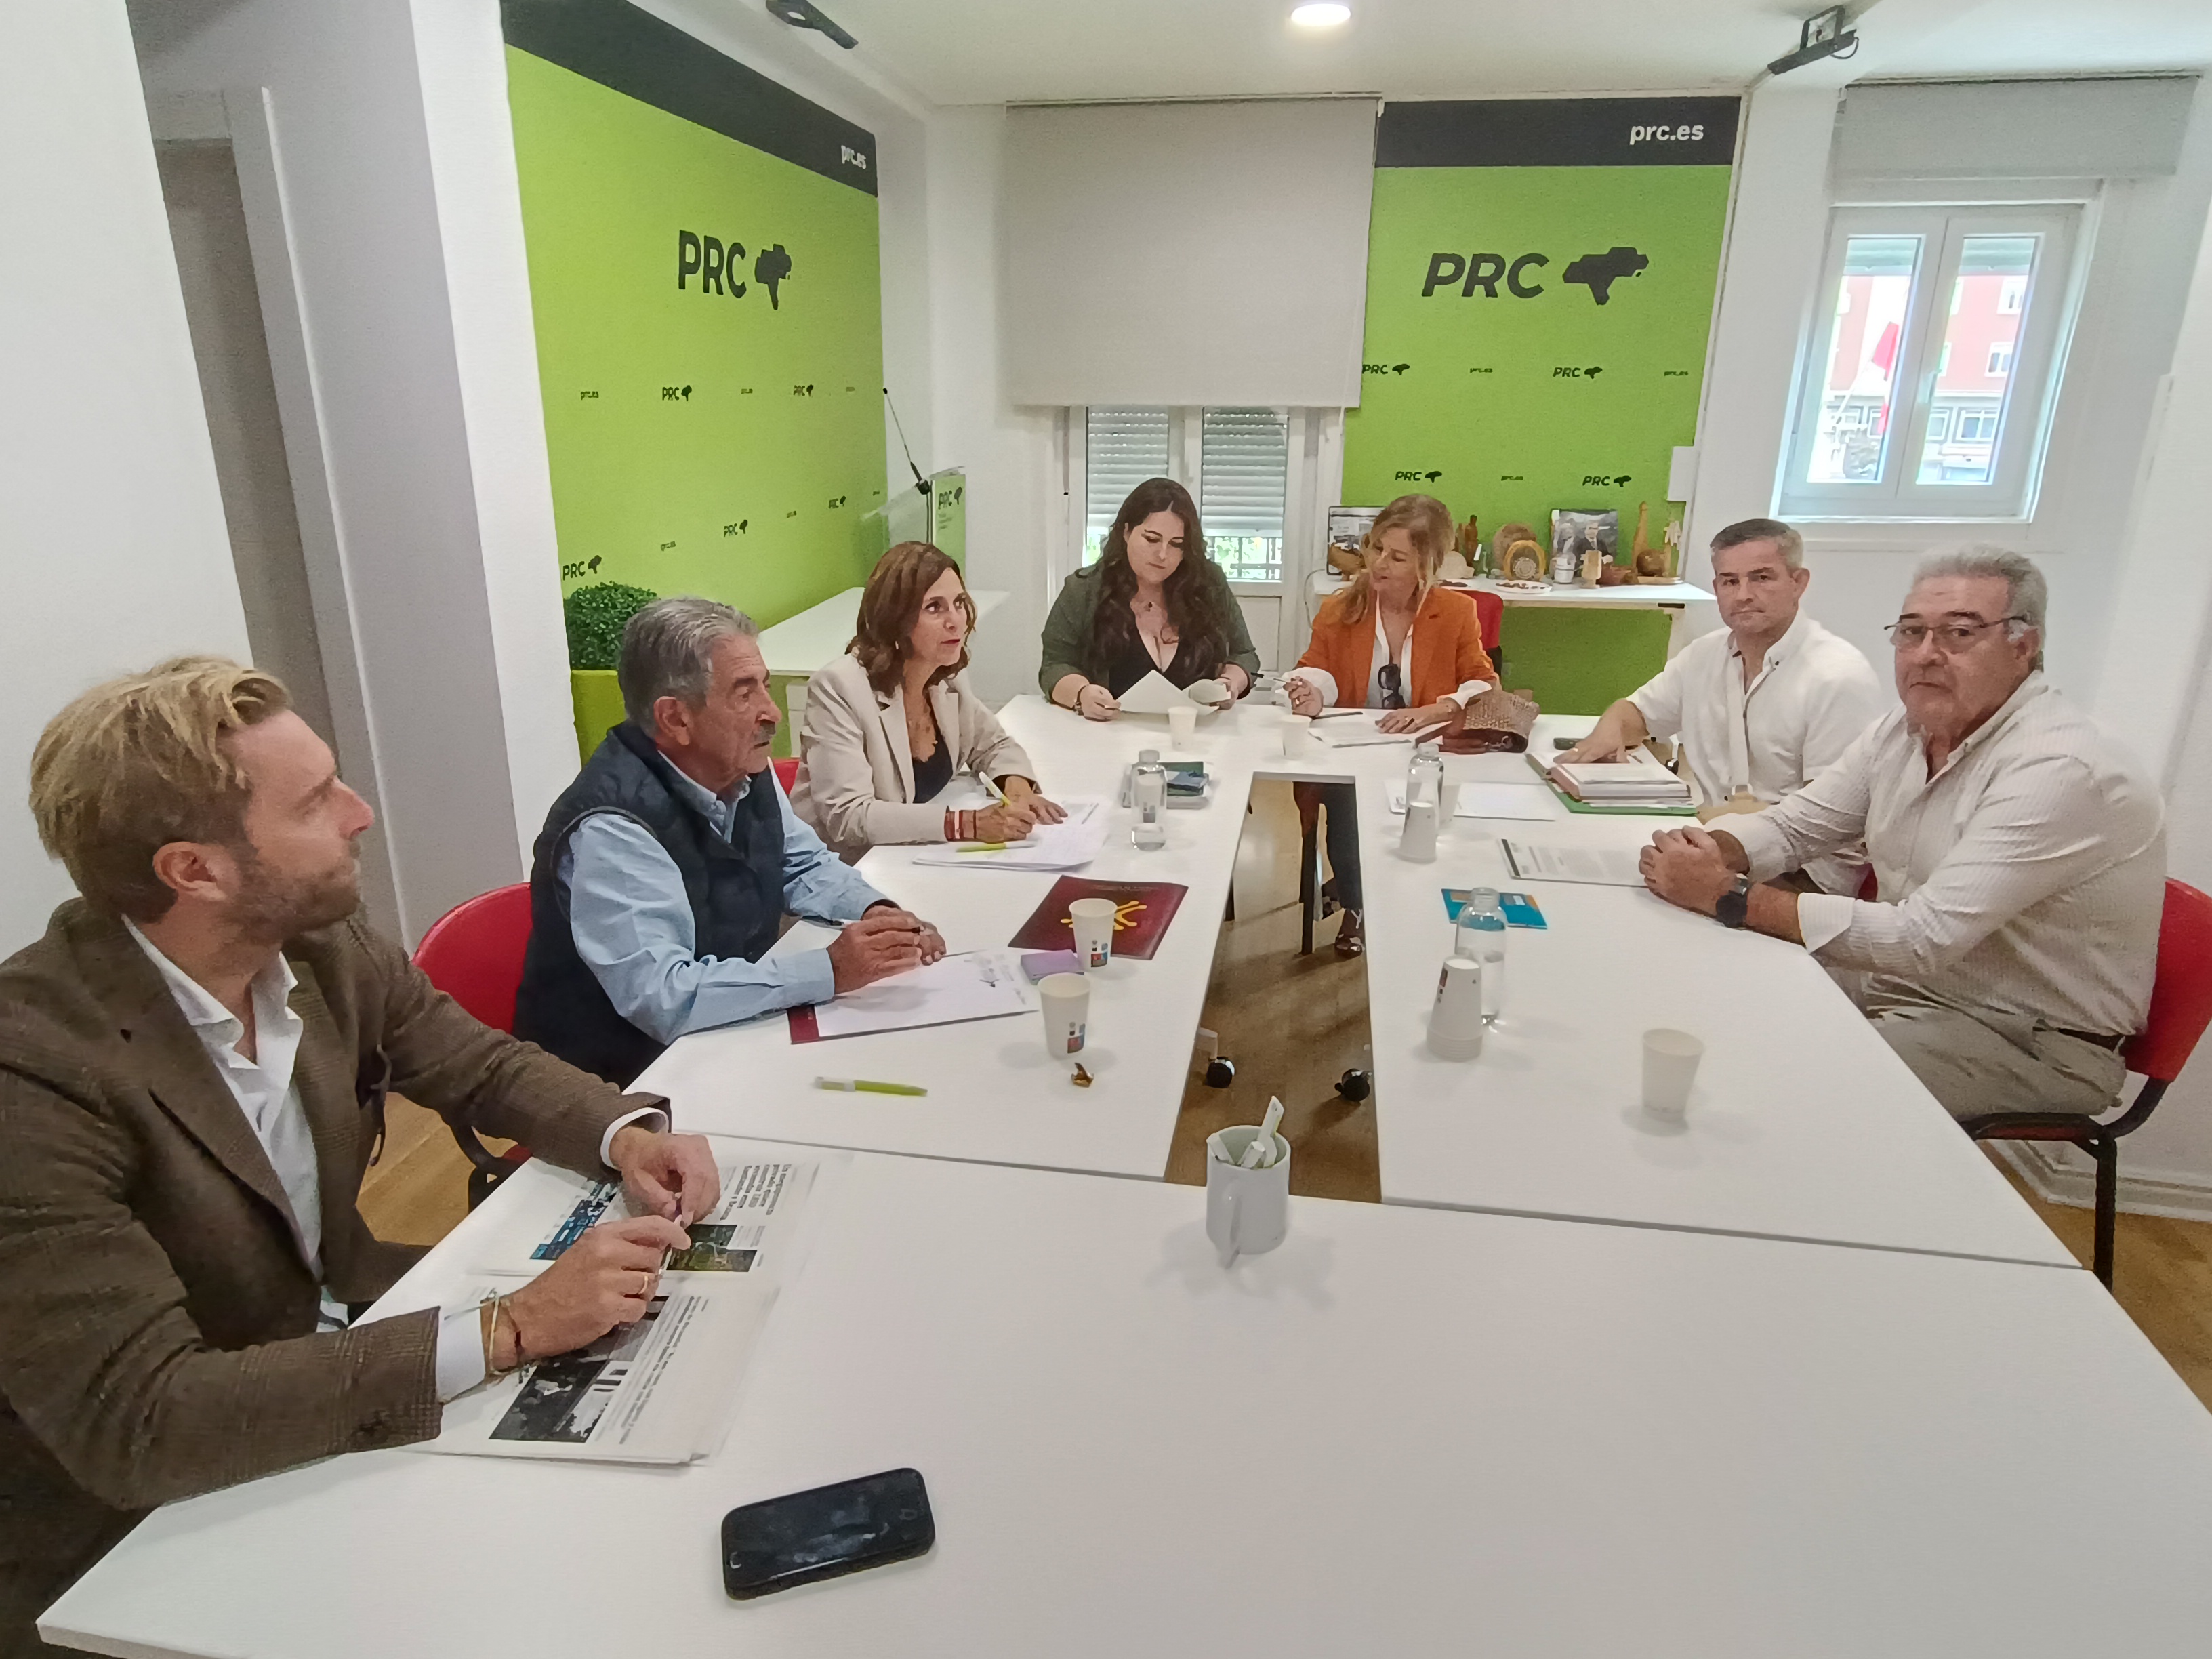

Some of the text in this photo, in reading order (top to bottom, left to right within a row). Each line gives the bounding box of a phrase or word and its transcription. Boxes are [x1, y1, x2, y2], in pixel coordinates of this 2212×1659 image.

[1629, 123, 1704, 145] prc.es
[678, 229, 747, 299] PRC
[1421, 253, 1550, 298] PRC
[1362, 364, 1389, 375] PRC
[1552, 367, 1581, 377] PRC
[662, 386, 680, 401] PRC
[1395, 471, 1422, 481] PRC
[1582, 475, 1611, 487] PRC
[562, 560, 586, 581] PRC
